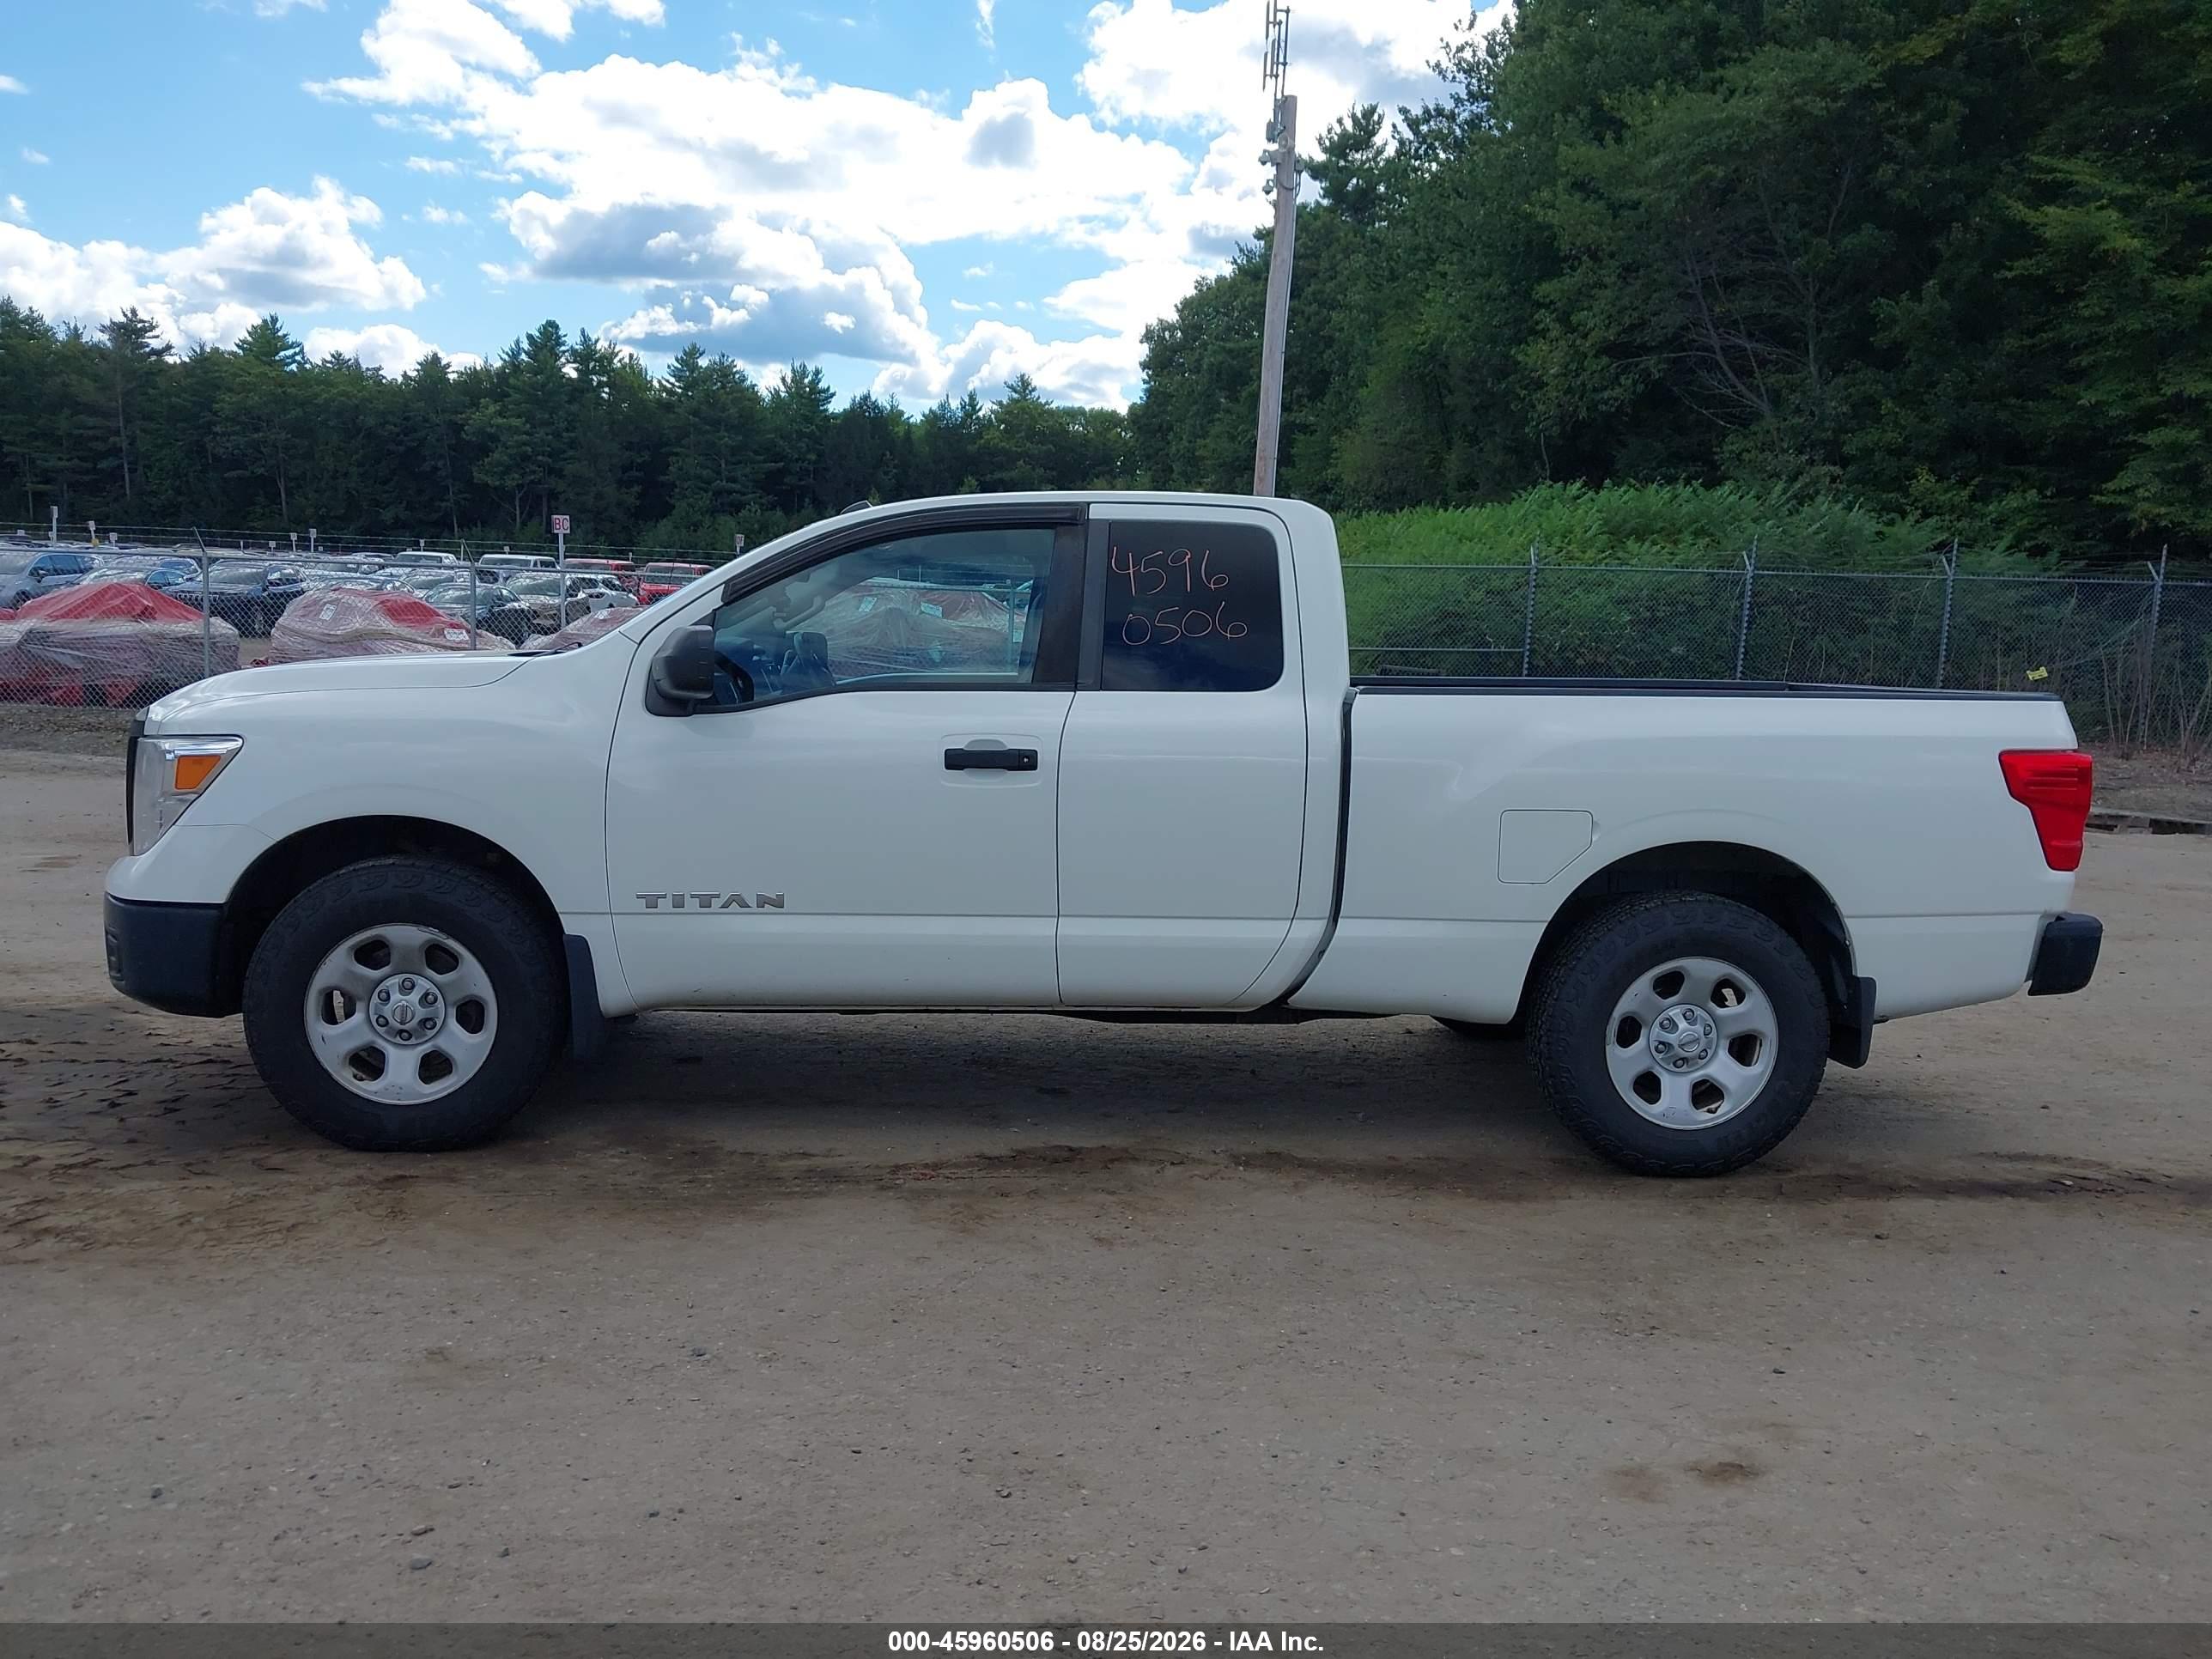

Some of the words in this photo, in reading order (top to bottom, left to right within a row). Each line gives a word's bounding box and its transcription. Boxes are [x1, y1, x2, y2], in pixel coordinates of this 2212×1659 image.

[554, 518, 568, 530] BC
[1111, 546, 1229, 596] 4596
[1122, 601, 1248, 646] 0506
[635, 891, 785, 909] TITAN
